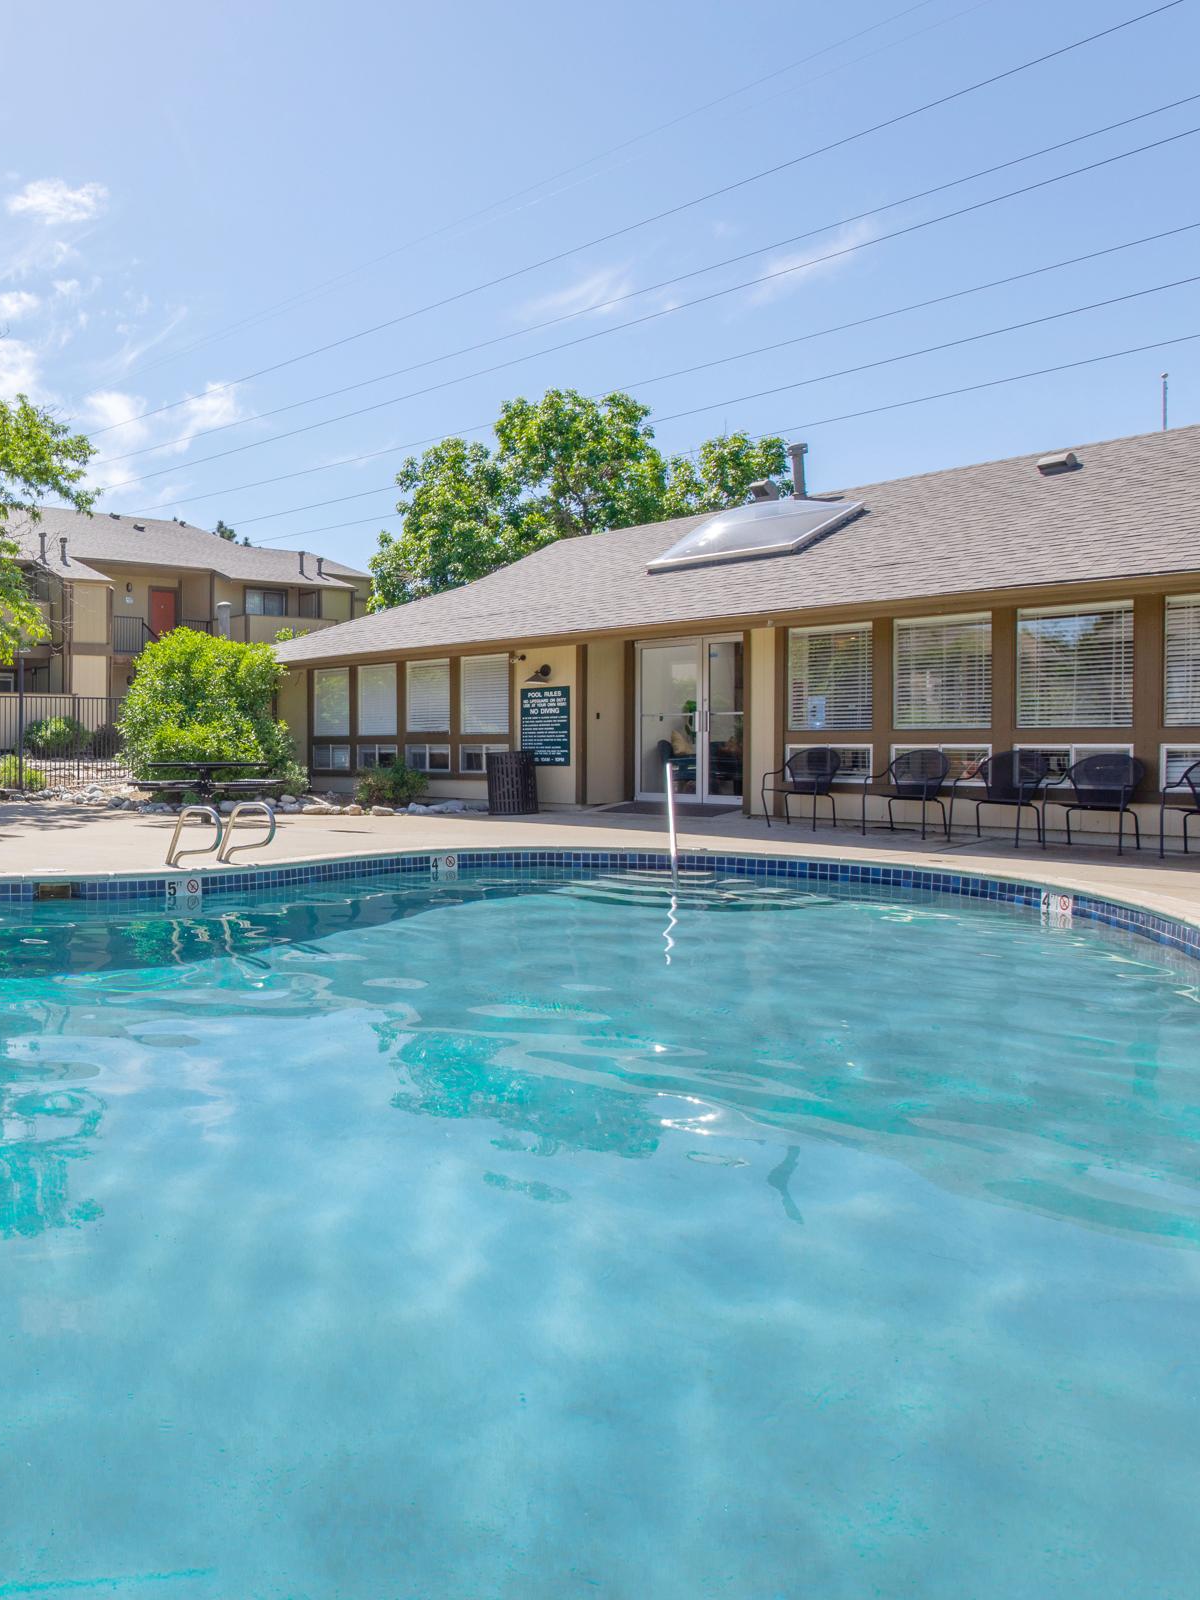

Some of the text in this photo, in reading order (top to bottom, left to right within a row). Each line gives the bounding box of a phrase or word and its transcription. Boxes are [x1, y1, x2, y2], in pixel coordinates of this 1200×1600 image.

[432, 857, 438, 870] 4
[168, 881, 176, 896] 5
[1042, 893, 1049, 909] 4
